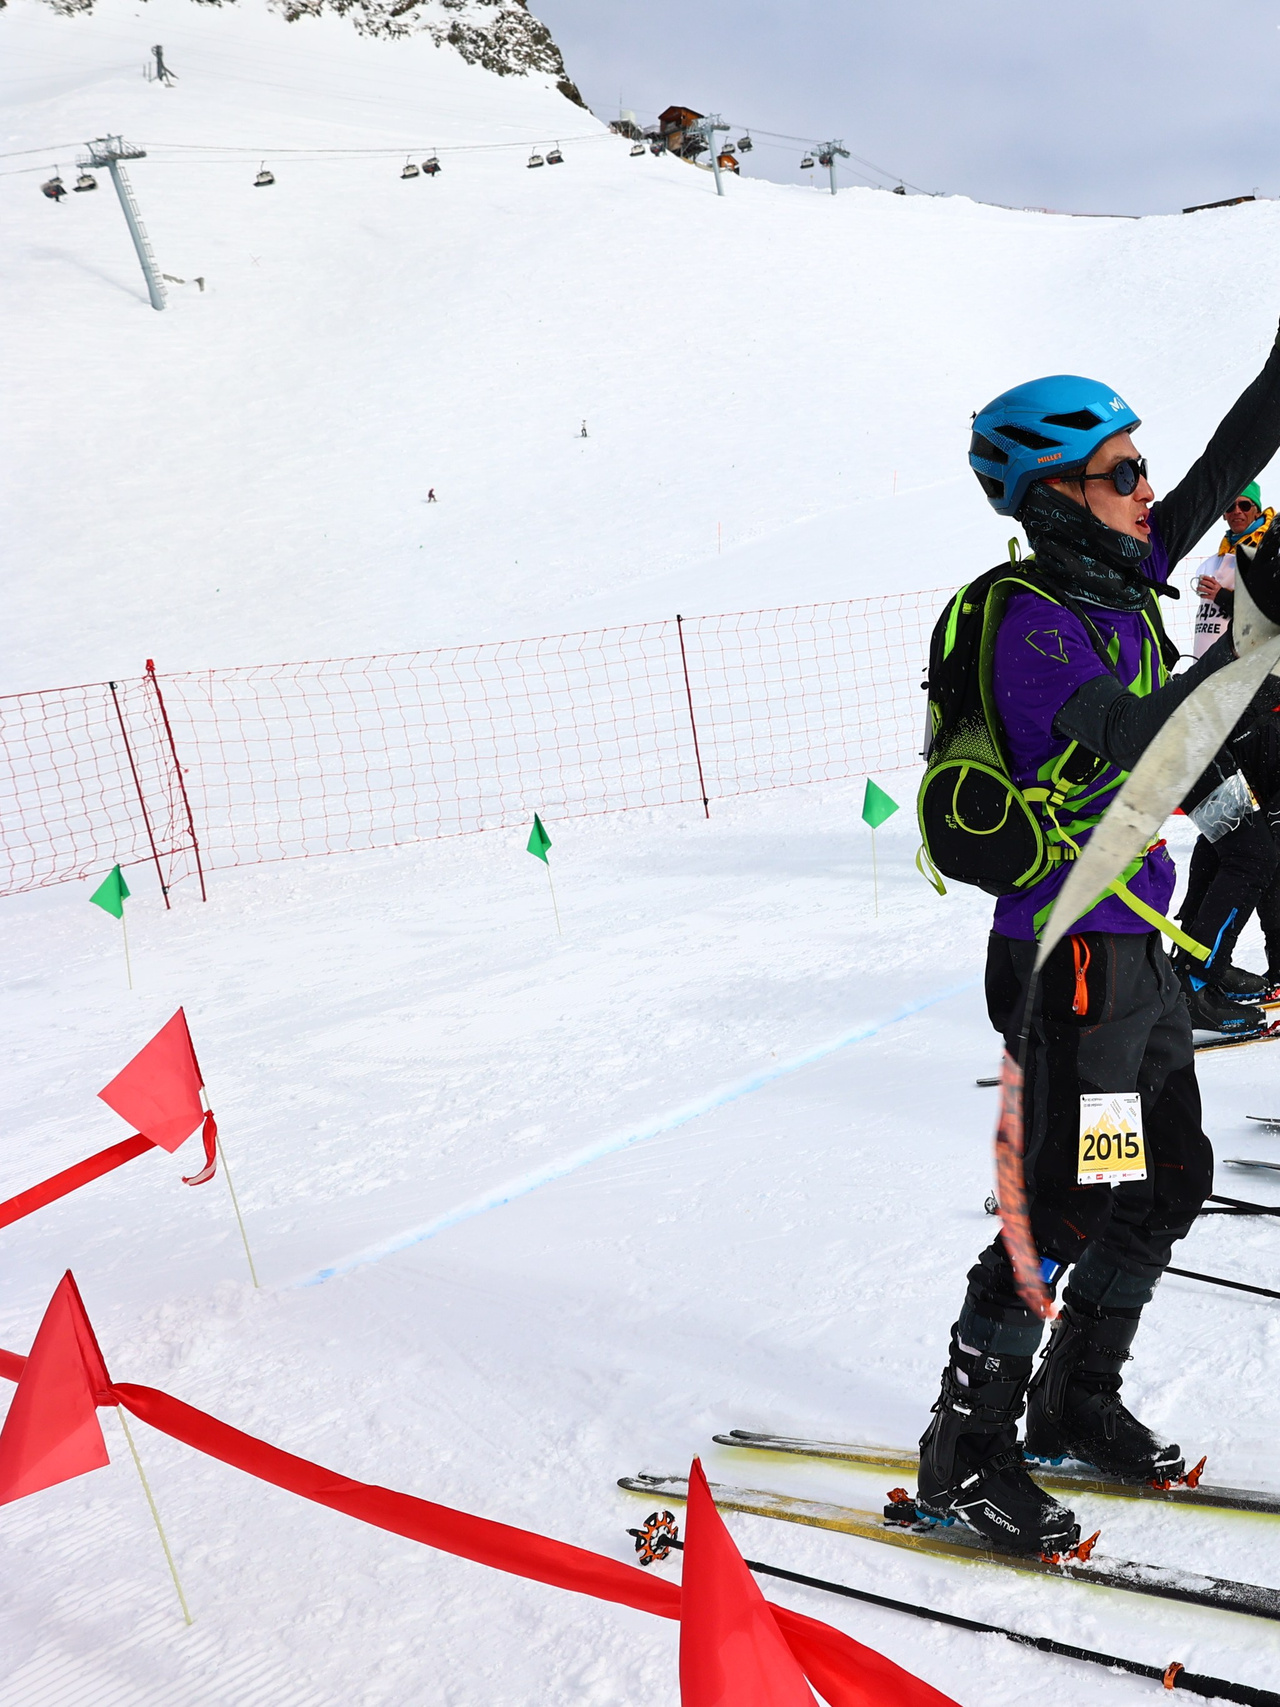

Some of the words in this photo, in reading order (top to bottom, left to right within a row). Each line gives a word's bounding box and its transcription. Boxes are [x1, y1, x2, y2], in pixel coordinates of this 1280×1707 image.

[1037, 452, 1063, 464] MILLET
[1082, 1132, 1140, 1162] 2015
[983, 1506, 1021, 1536] salomon
